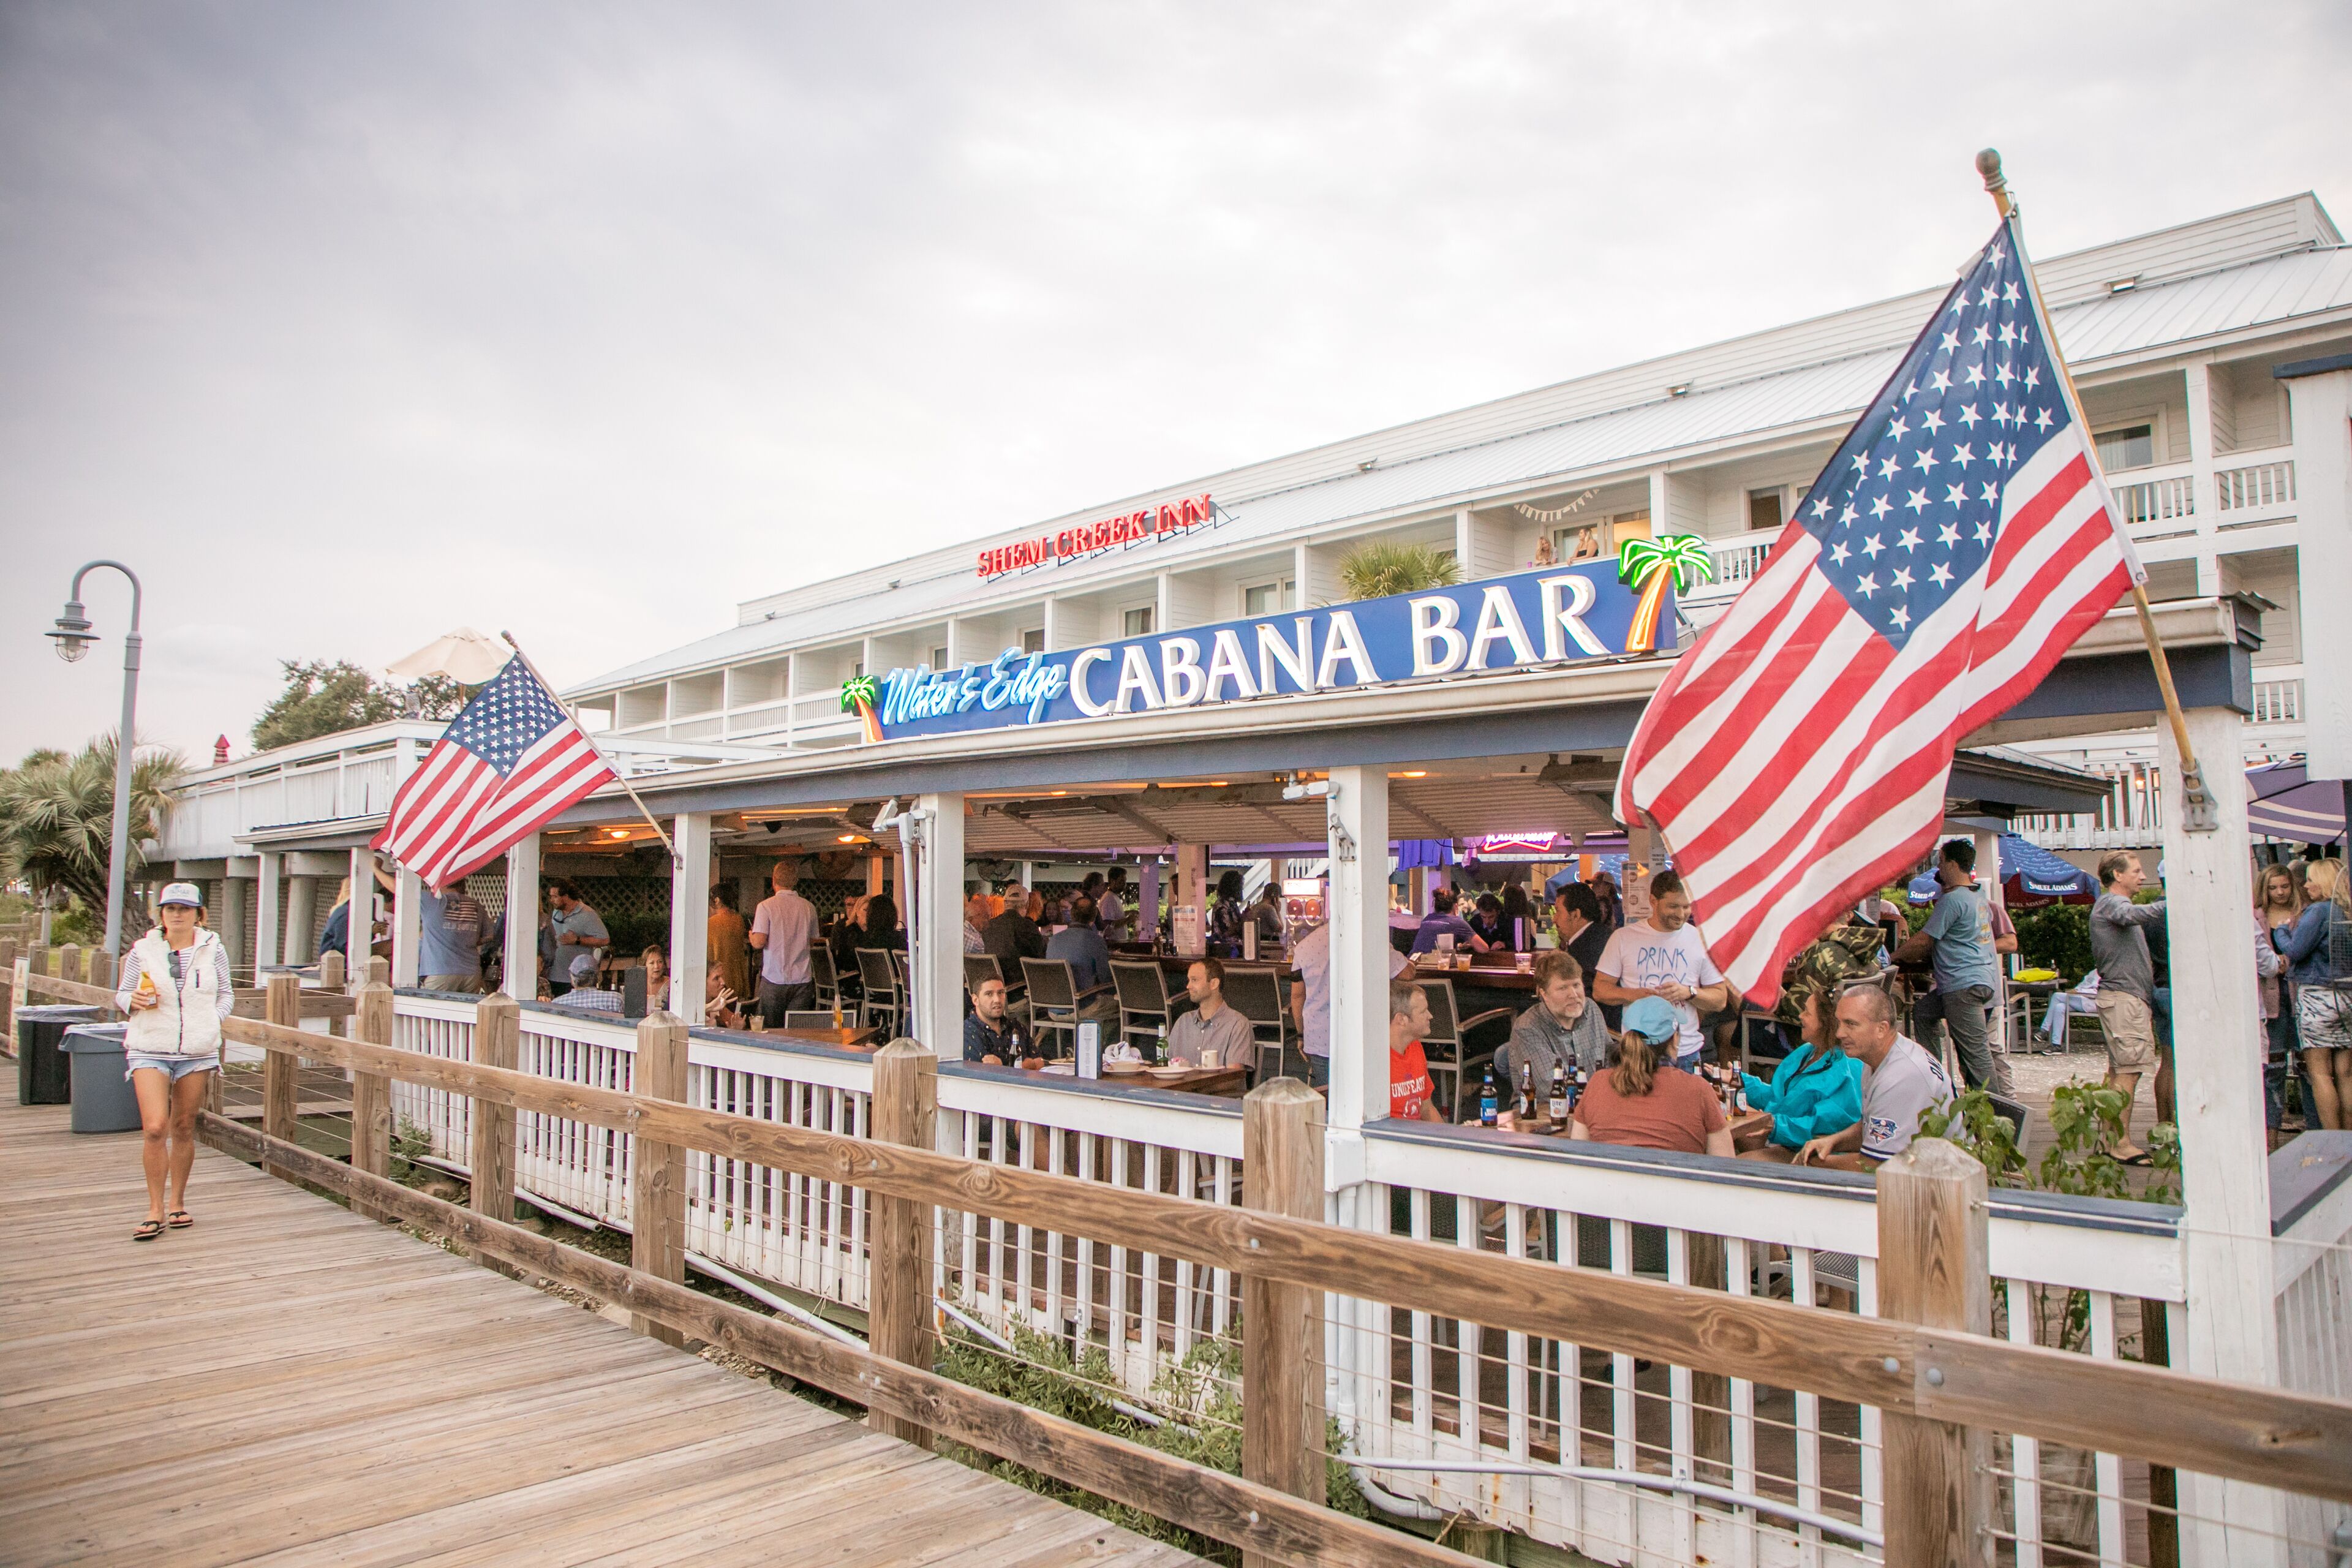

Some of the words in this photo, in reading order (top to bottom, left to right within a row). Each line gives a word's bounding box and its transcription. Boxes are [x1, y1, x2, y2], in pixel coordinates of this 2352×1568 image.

[978, 537, 1047, 576] SHEM
[1054, 510, 1148, 558] CREEK
[1154, 493, 1211, 532] INN
[882, 662, 981, 726] Water's
[981, 646, 1067, 724] Edge
[1070, 611, 1382, 717] CABANA
[1409, 575, 1611, 677] BAR
[2029, 881, 2051, 891] SAMUEL
[1637, 947, 1688, 972] DRINK
